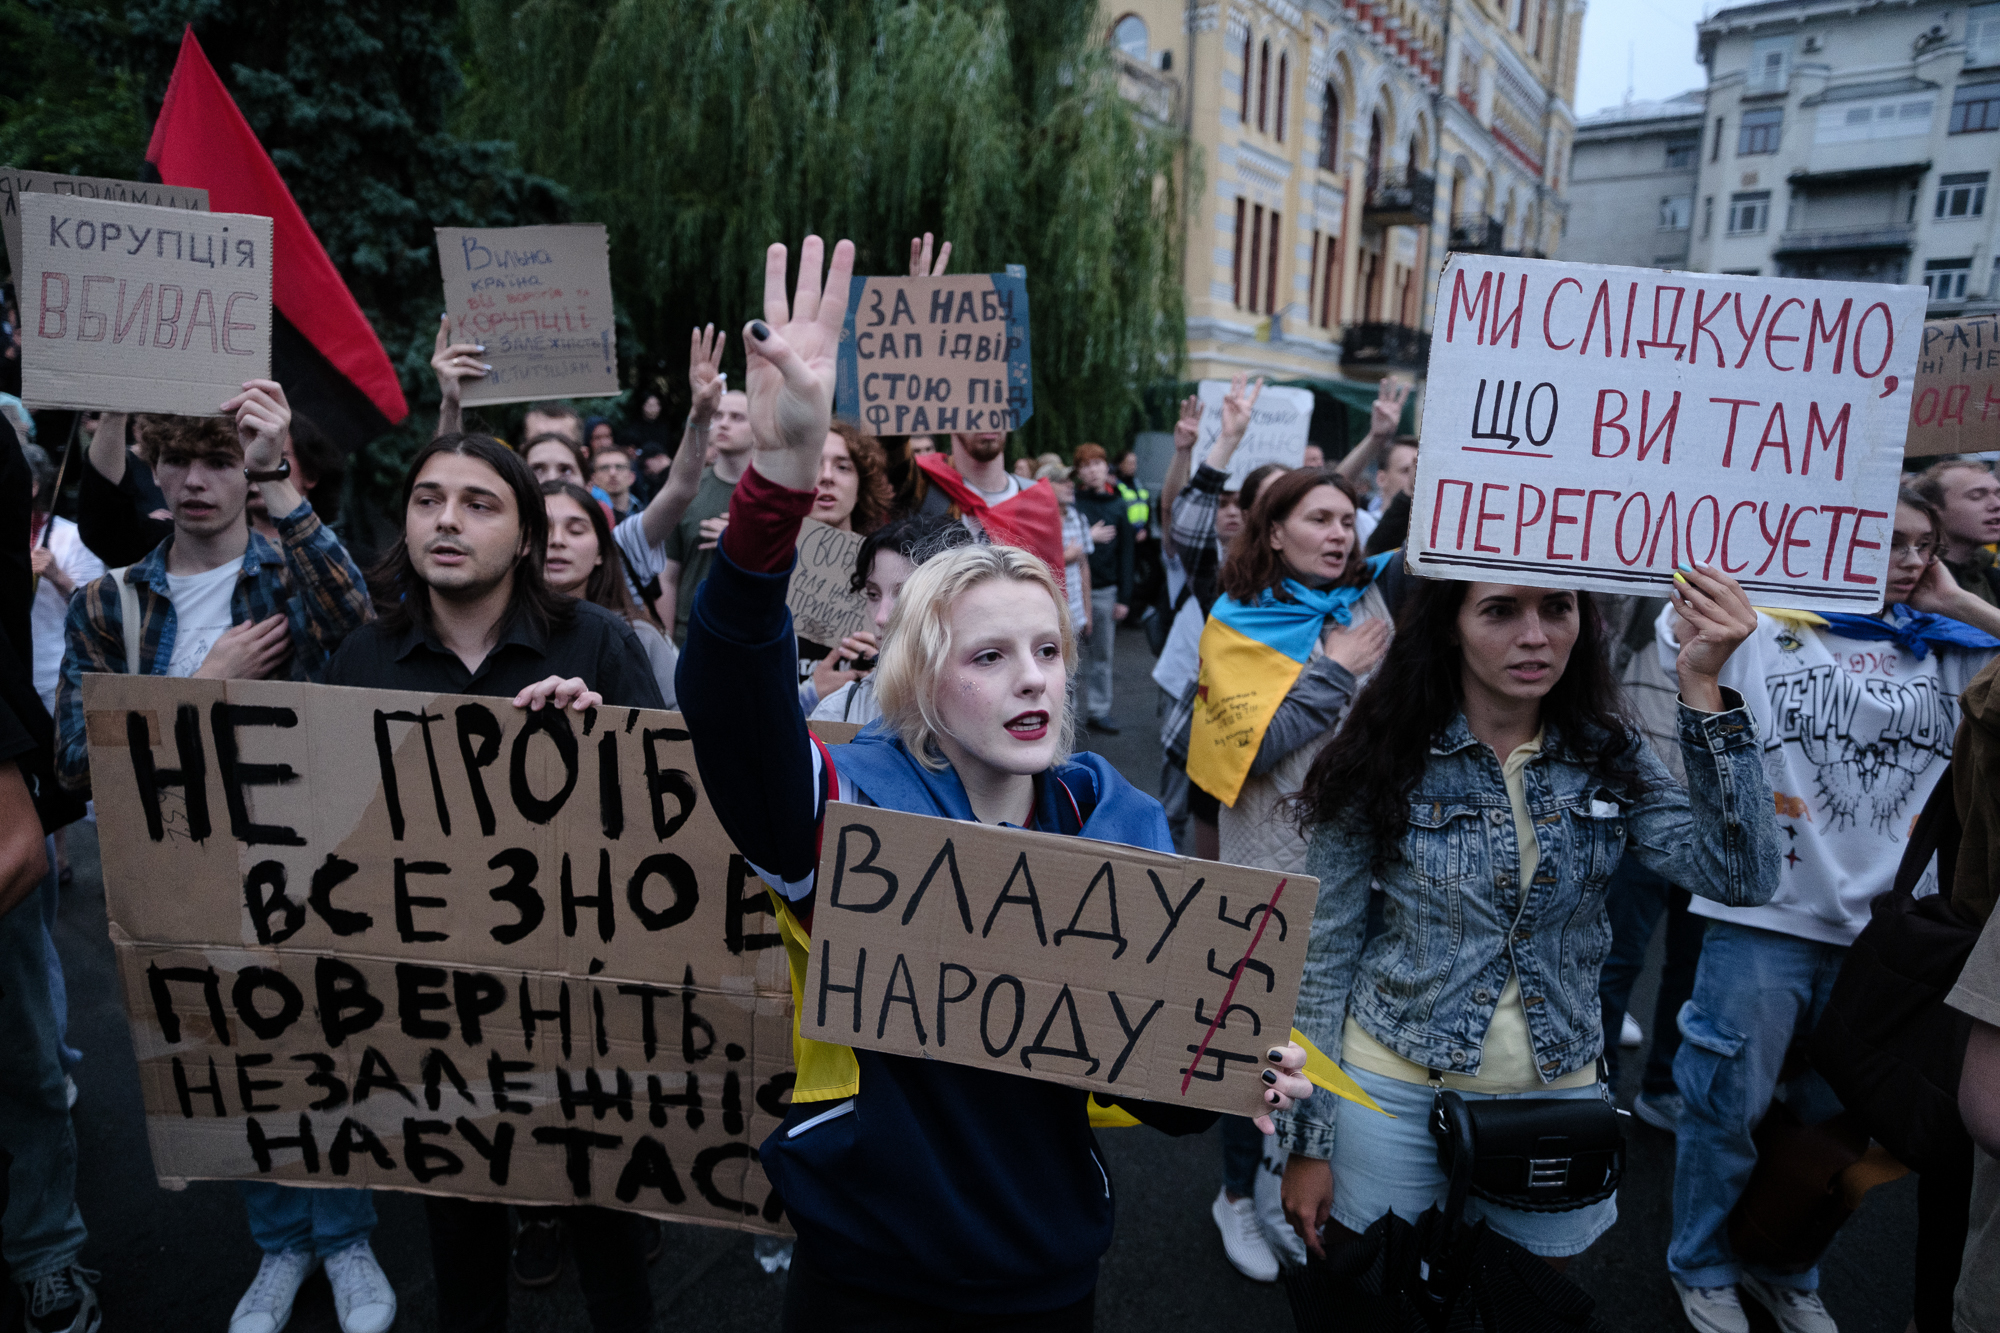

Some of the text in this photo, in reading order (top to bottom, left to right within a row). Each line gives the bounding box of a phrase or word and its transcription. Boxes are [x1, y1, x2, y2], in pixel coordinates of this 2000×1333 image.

[37, 271, 259, 355] ВБИВАЄ
[856, 331, 923, 361] САП
[866, 288, 916, 327] ЗА
[1445, 267, 1900, 399] МИ СЛІДКУЄМО,
[863, 371, 952, 403] СТОЮ
[1470, 377, 1852, 482] ЩО ВИ ТАМ
[1912, 384, 1971, 428] ОД
[800, 525, 858, 570] СВОБ
[1428, 477, 1890, 585] ПЕРЕГОЛОСУЄТЕ
[1764, 664, 1861, 752] EW
[125, 700, 700, 849] НЕ ПРОЇБ
[241, 852, 452, 946] ВСЕ
[830, 823, 1206, 965] ВЛАДУ
[816, 939, 1165, 1084] НАРОДУ
[172, 1045, 797, 1136] НЕЗАЛЕЖНІС
[246, 1112, 516, 1188] НАБУ
